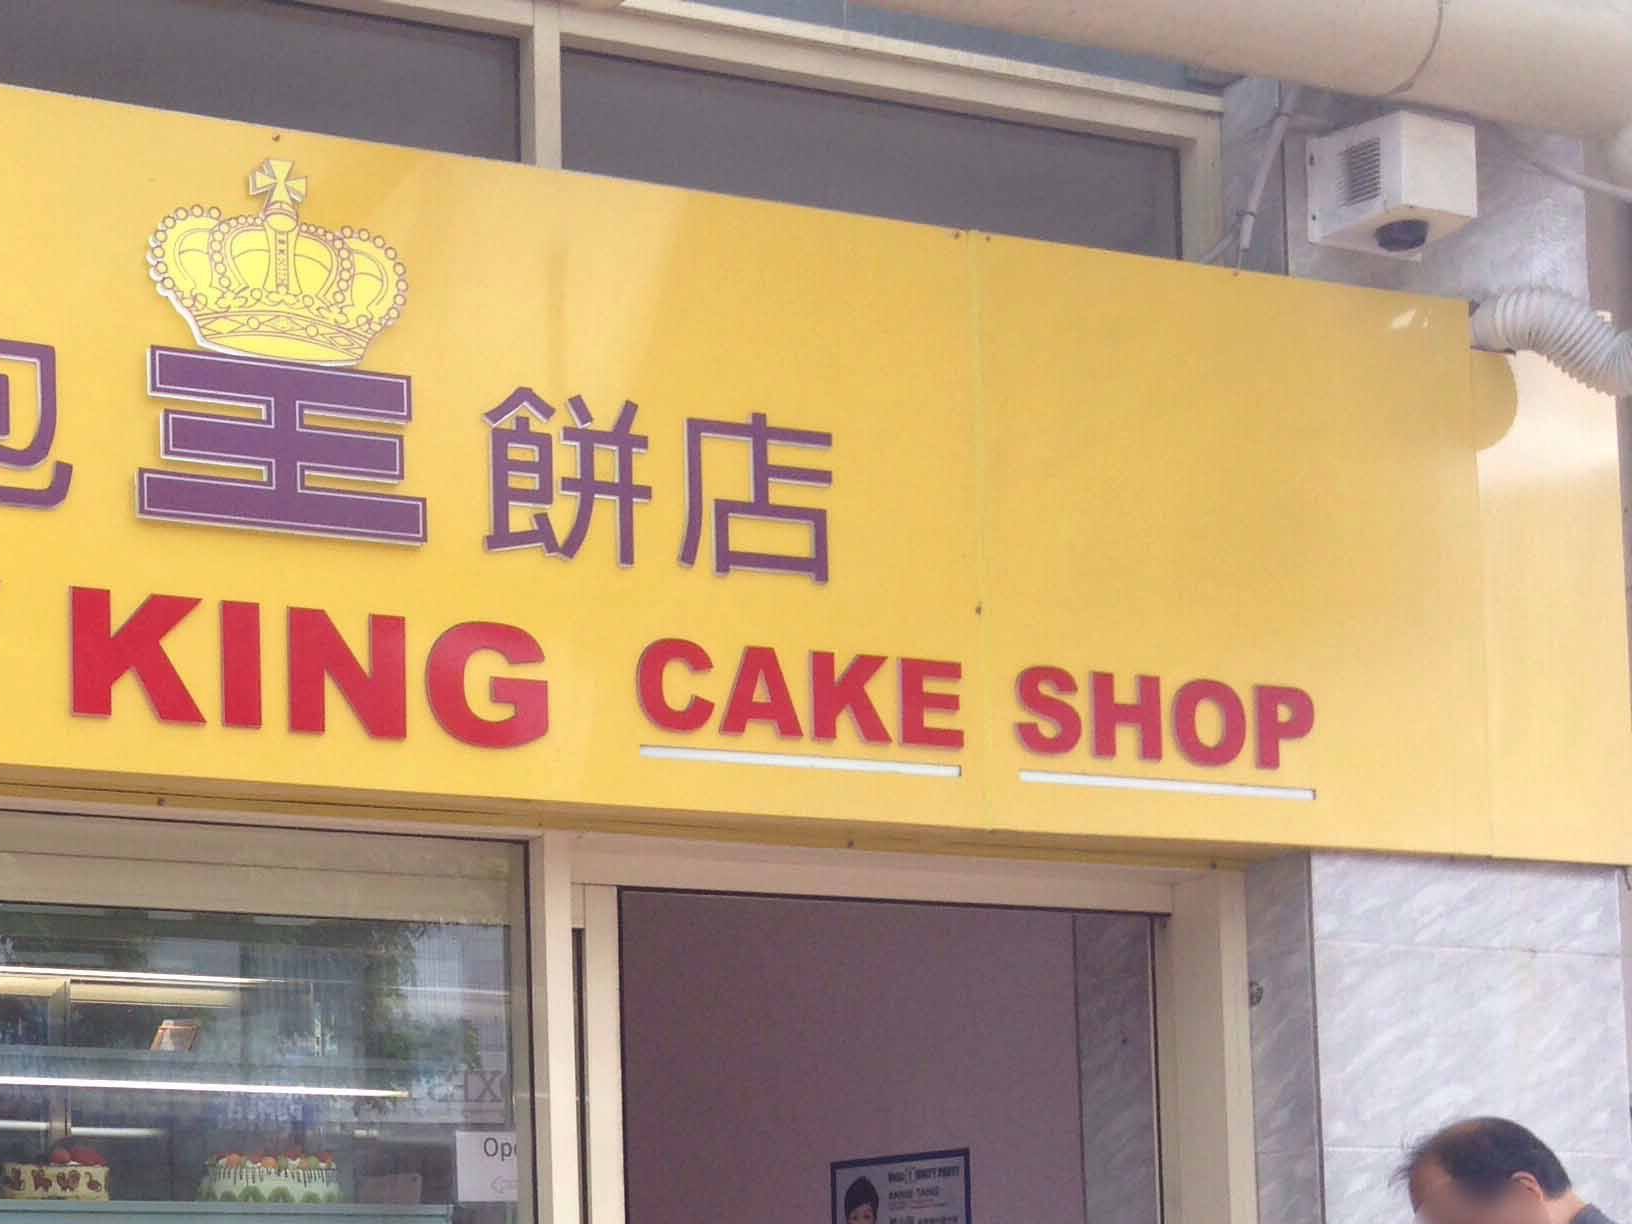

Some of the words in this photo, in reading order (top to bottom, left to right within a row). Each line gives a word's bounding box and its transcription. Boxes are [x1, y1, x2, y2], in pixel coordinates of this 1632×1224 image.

[68, 584, 549, 750] KING
[635, 637, 966, 750] CAKE
[1014, 663, 1316, 771] SHOP
